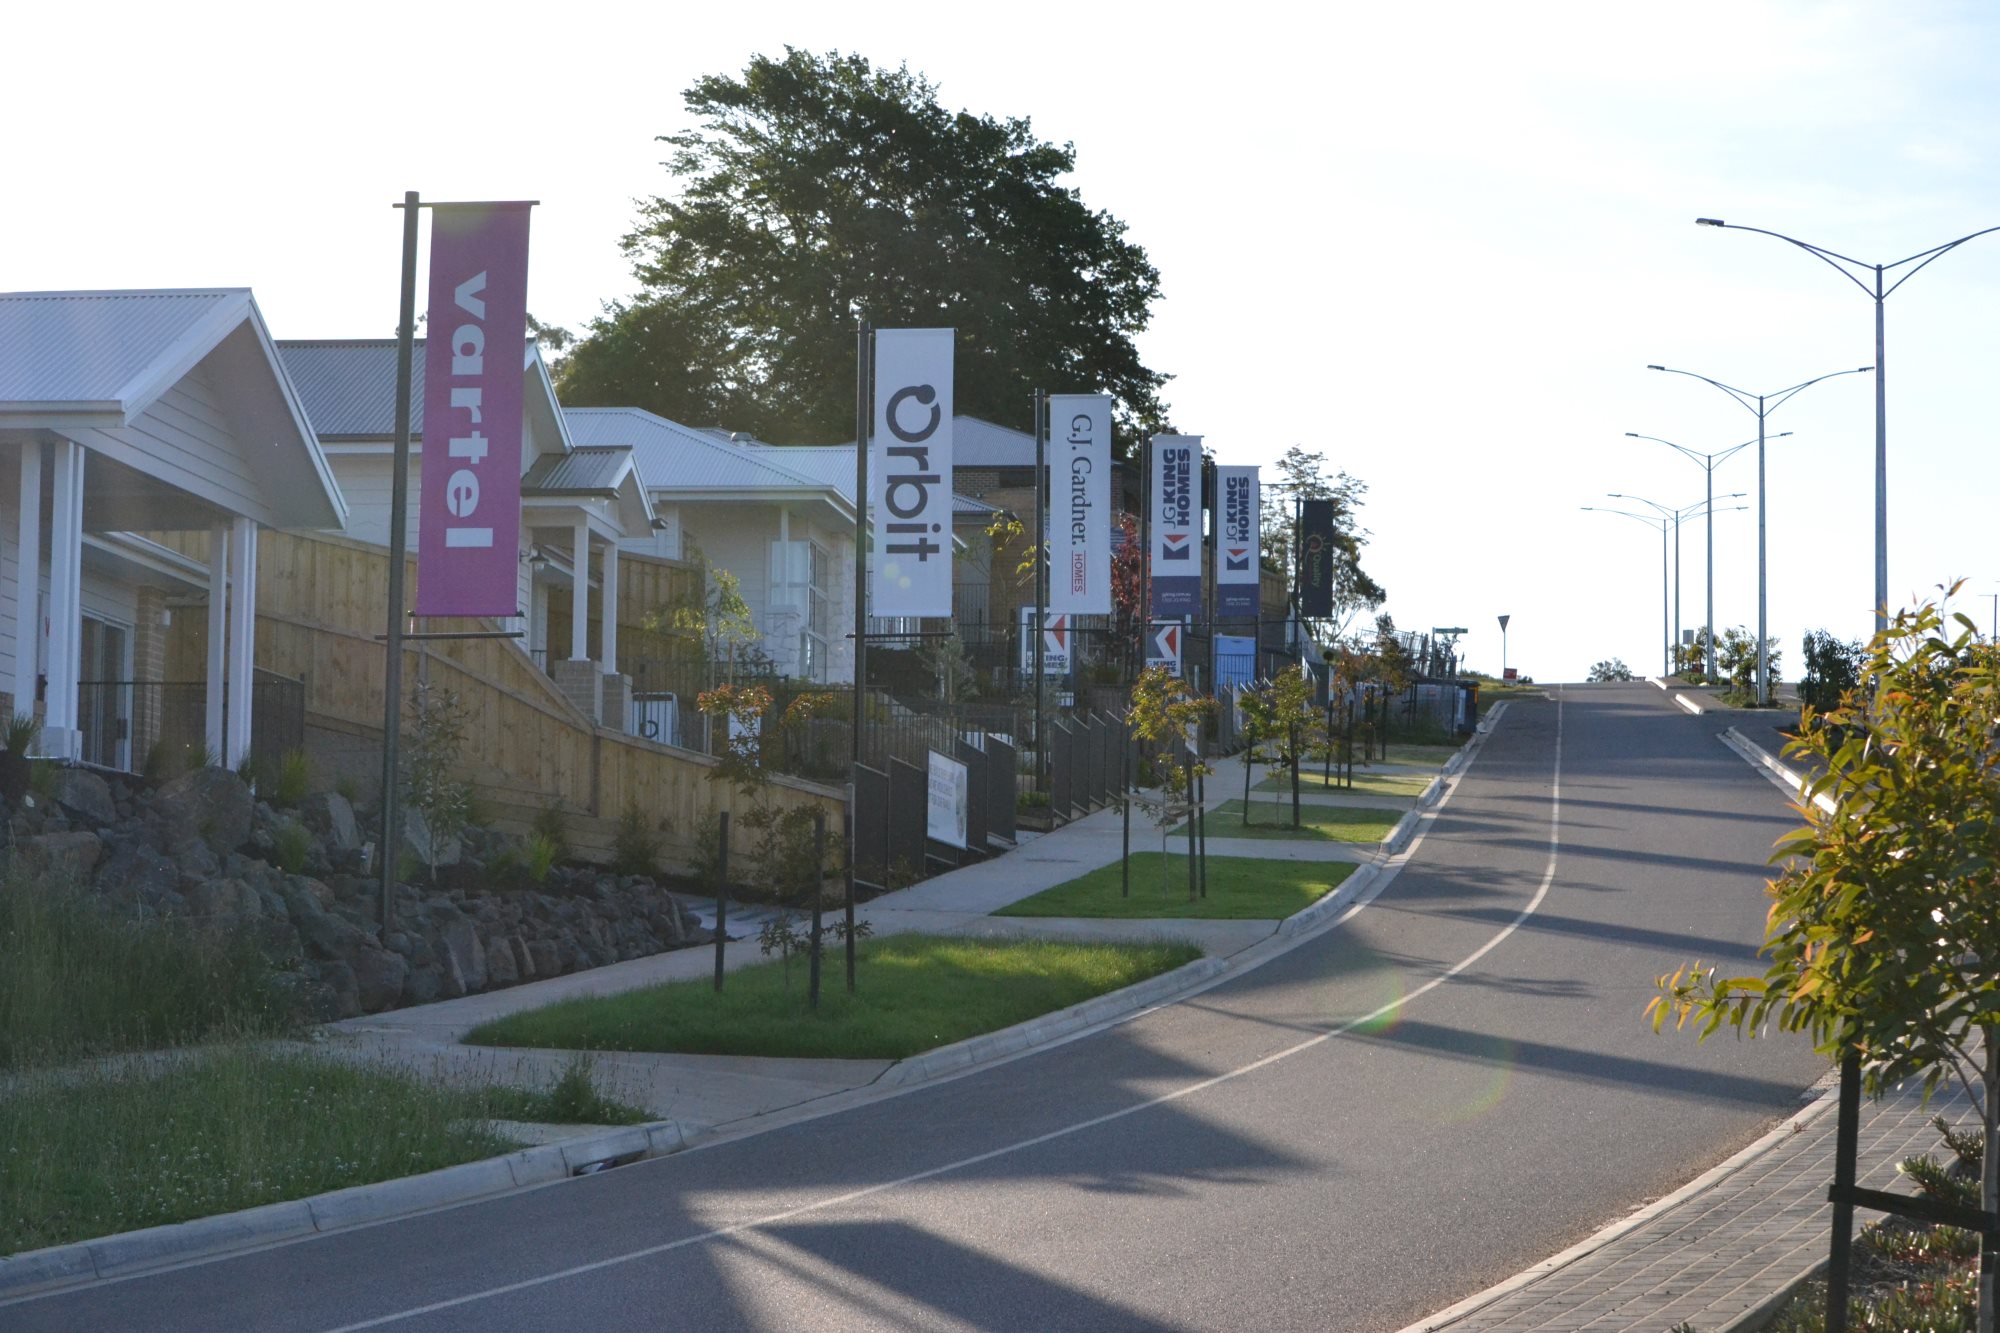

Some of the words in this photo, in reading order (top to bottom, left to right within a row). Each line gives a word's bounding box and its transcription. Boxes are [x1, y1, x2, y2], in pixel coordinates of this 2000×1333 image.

[446, 270, 494, 547] vartel
[1067, 414, 1092, 451] G.J.
[885, 384, 942, 561] Orbit
[1071, 456, 1092, 545] Gardner.
[1176, 448, 1191, 526] HOMES
[1238, 476, 1250, 542] HOMES
[1074, 553, 1084, 592] HOMES
